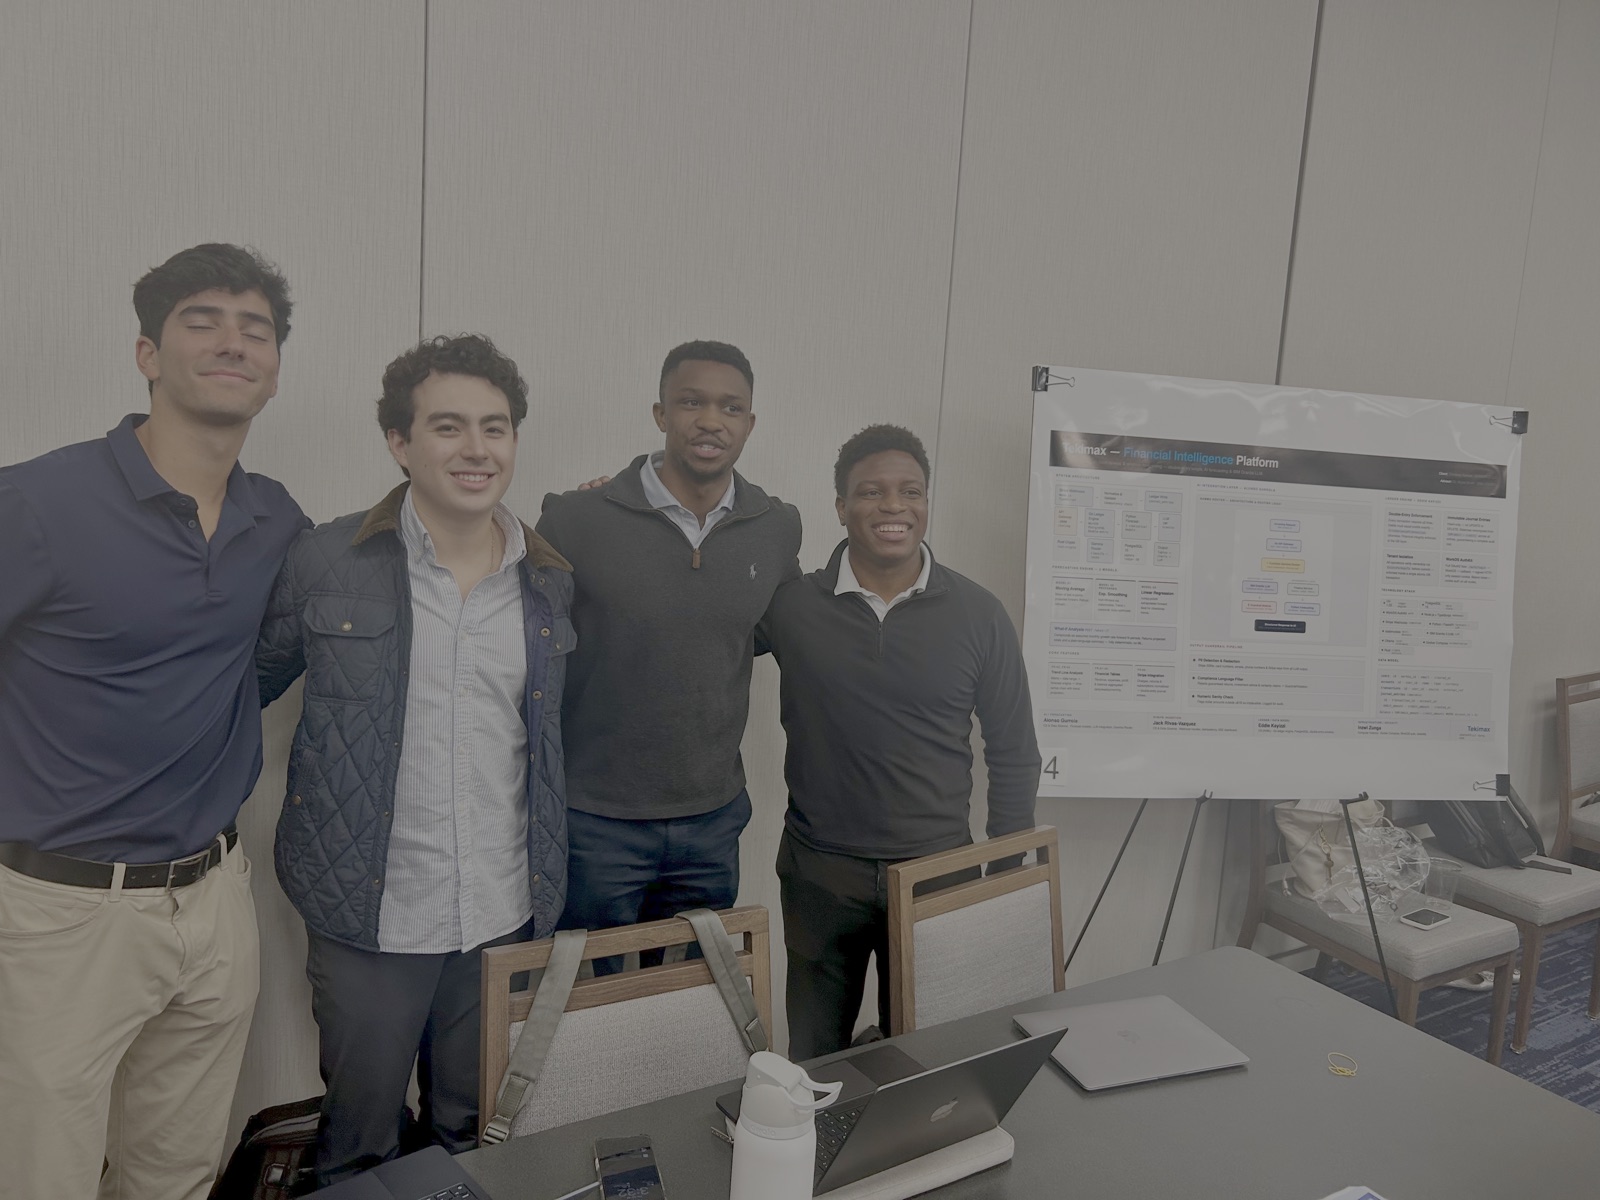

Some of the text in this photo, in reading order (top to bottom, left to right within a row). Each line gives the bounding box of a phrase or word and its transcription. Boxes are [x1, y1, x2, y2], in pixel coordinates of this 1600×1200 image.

[1123, 446, 1171, 460] Financial
[1174, 450, 1234, 466] Intelligence
[1236, 455, 1279, 468] Platform
[1043, 756, 1059, 779] 4
